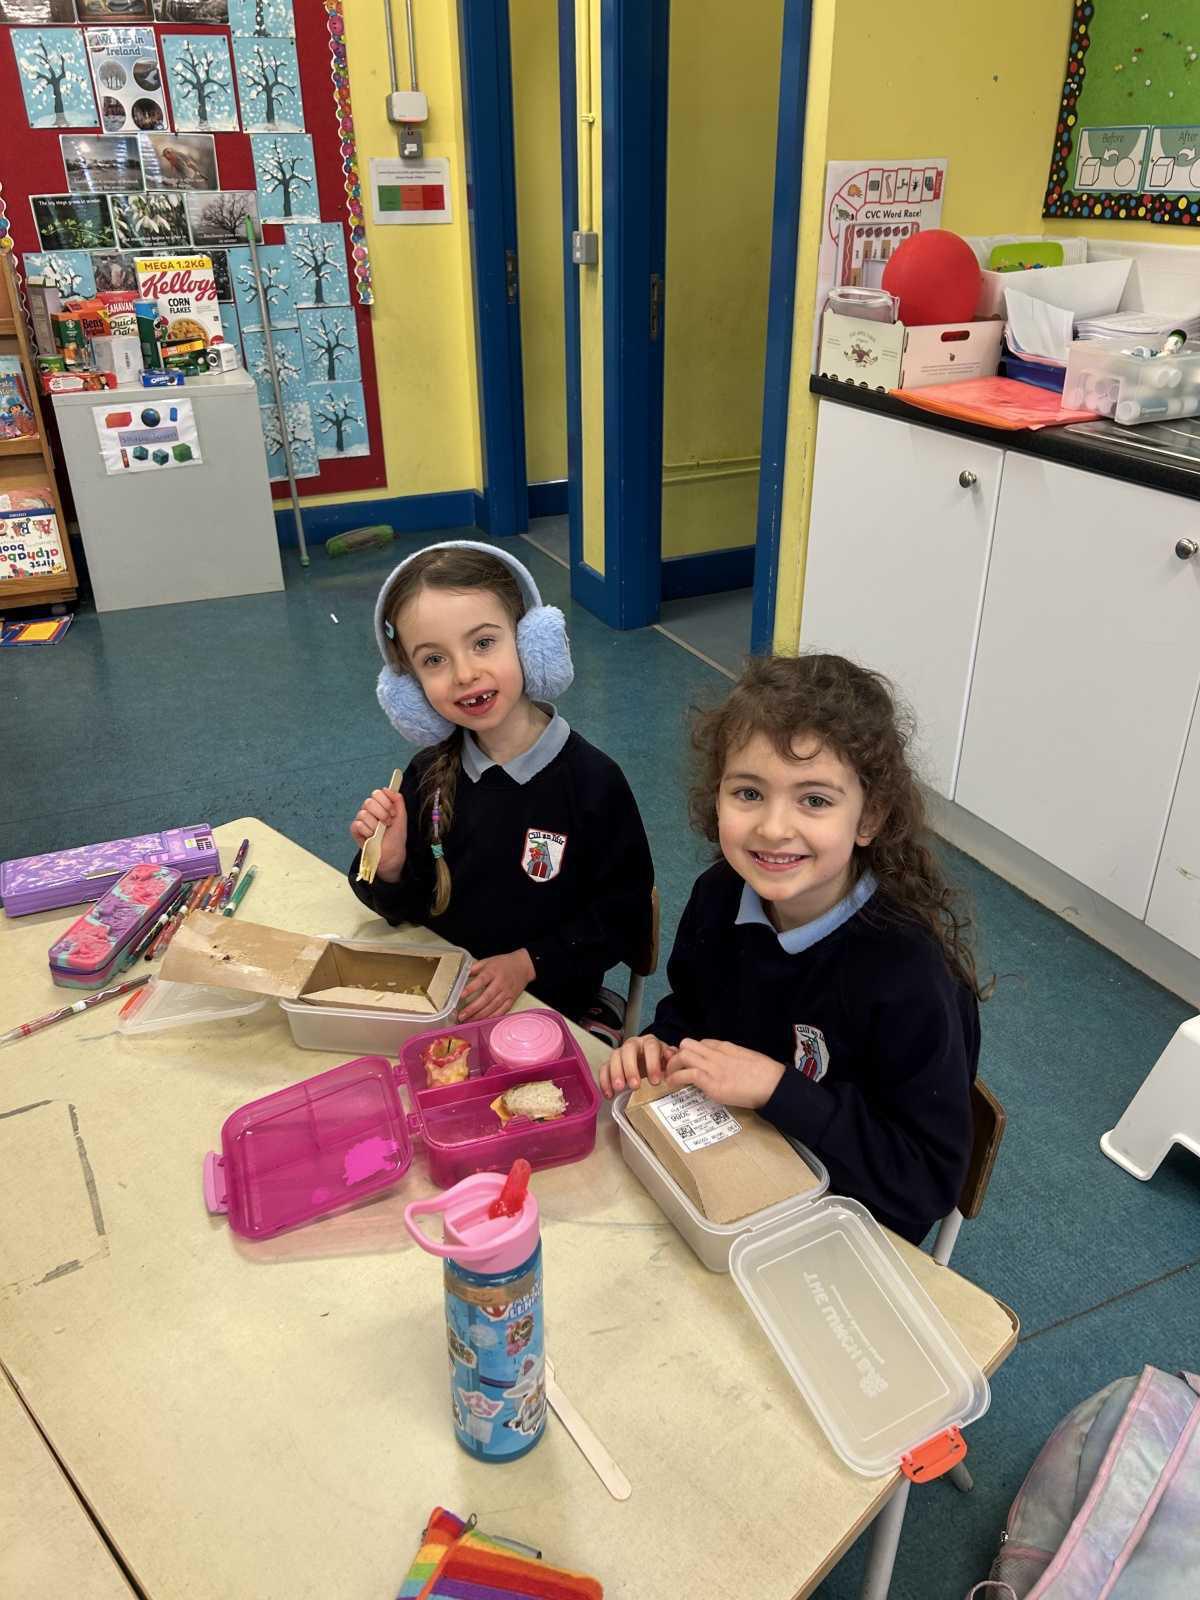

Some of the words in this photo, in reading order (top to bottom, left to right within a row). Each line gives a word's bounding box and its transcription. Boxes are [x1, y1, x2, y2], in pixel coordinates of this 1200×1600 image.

[97, 34, 133, 45] Wite
[106, 46, 141, 56] Ireland
[1102, 132, 1125, 145] Before
[865, 210, 881, 219] CVC
[883, 210, 902, 219] Word
[904, 209, 922, 218] Race!
[144, 261, 175, 271] MEGA
[176, 260, 205, 269] 1.2KG
[141, 270, 217, 302] Kellogg
[168, 297, 191, 307] CORN
[169, 306, 192, 314] FLAKES
[109, 317, 137, 329] Quick
[0, 543, 25, 554] boo
[0, 547, 59, 562] alphabe
[30, 560, 55, 569] first
